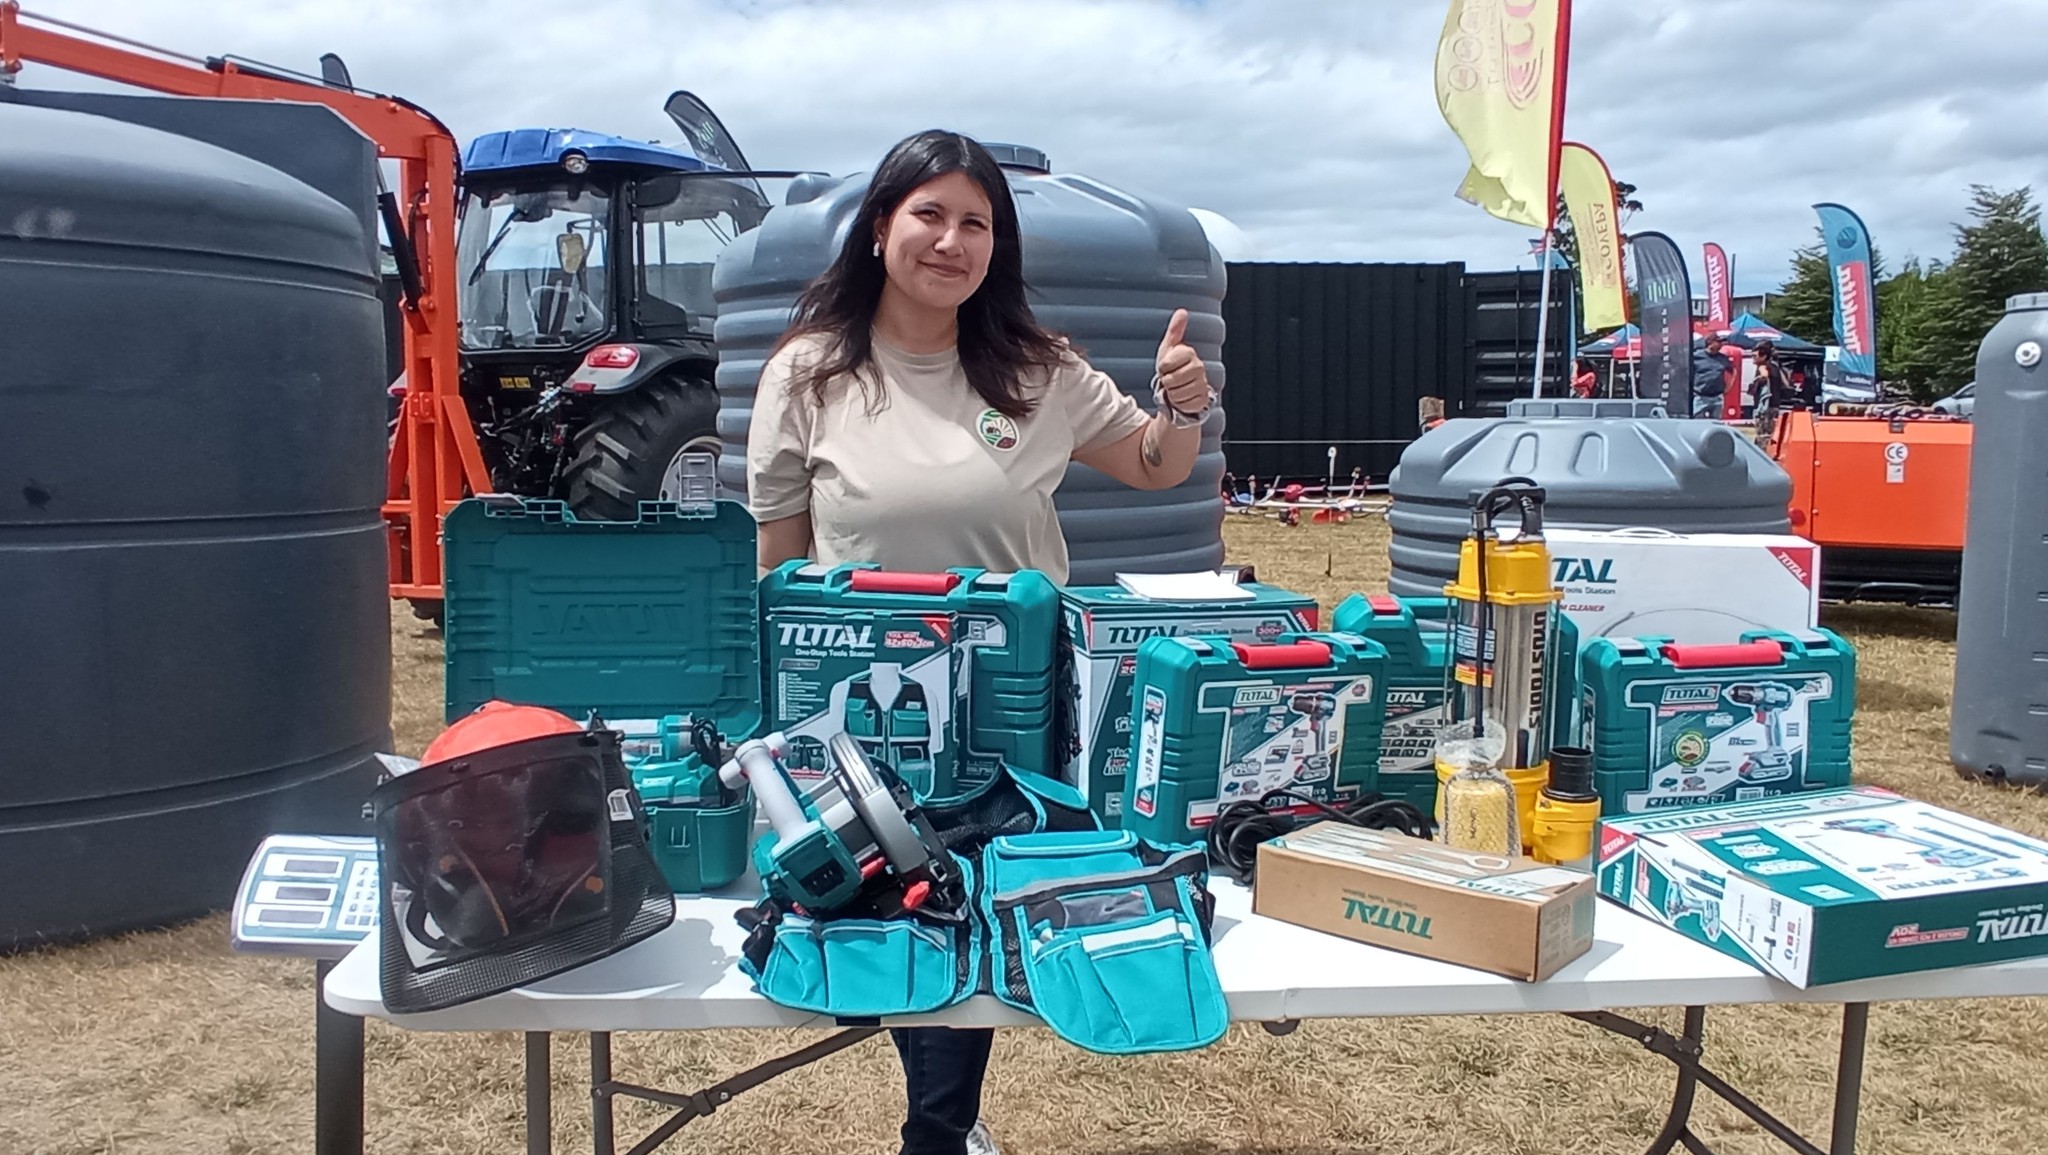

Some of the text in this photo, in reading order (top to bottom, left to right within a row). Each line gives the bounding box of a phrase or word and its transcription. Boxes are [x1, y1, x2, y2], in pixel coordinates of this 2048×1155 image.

[1887, 446, 1904, 459] CE
[1777, 551, 1807, 582] TOTAL
[778, 623, 876, 649] TOTAL
[1241, 690, 1275, 701] TOTAL
[1669, 688, 1711, 698] TOTAL
[1602, 833, 1626, 855] TOTAL
[1341, 898, 1433, 940] TOTAL
